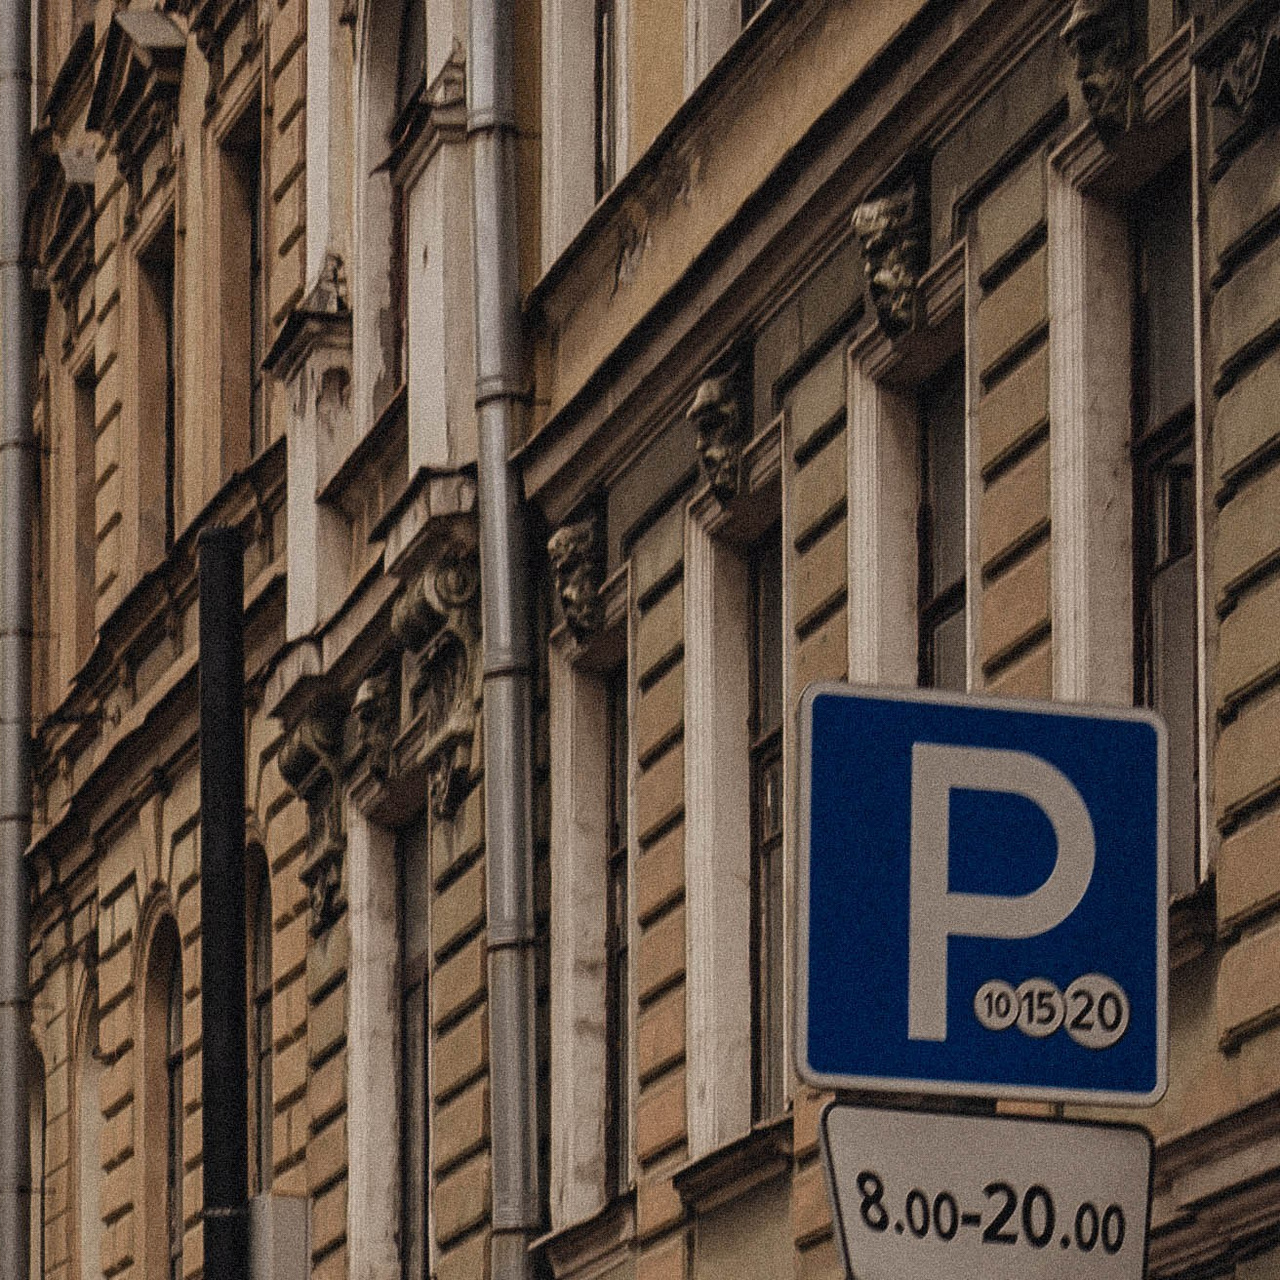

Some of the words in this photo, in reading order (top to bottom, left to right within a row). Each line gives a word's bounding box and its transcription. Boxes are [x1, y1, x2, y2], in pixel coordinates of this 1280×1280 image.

[909, 742, 1096, 1042] P
[983, 991, 1011, 1018] 10
[1021, 990, 1056, 1025] 15
[1071, 990, 1123, 1032] 20
[856, 1171, 1126, 1254] 8.00-20.00
